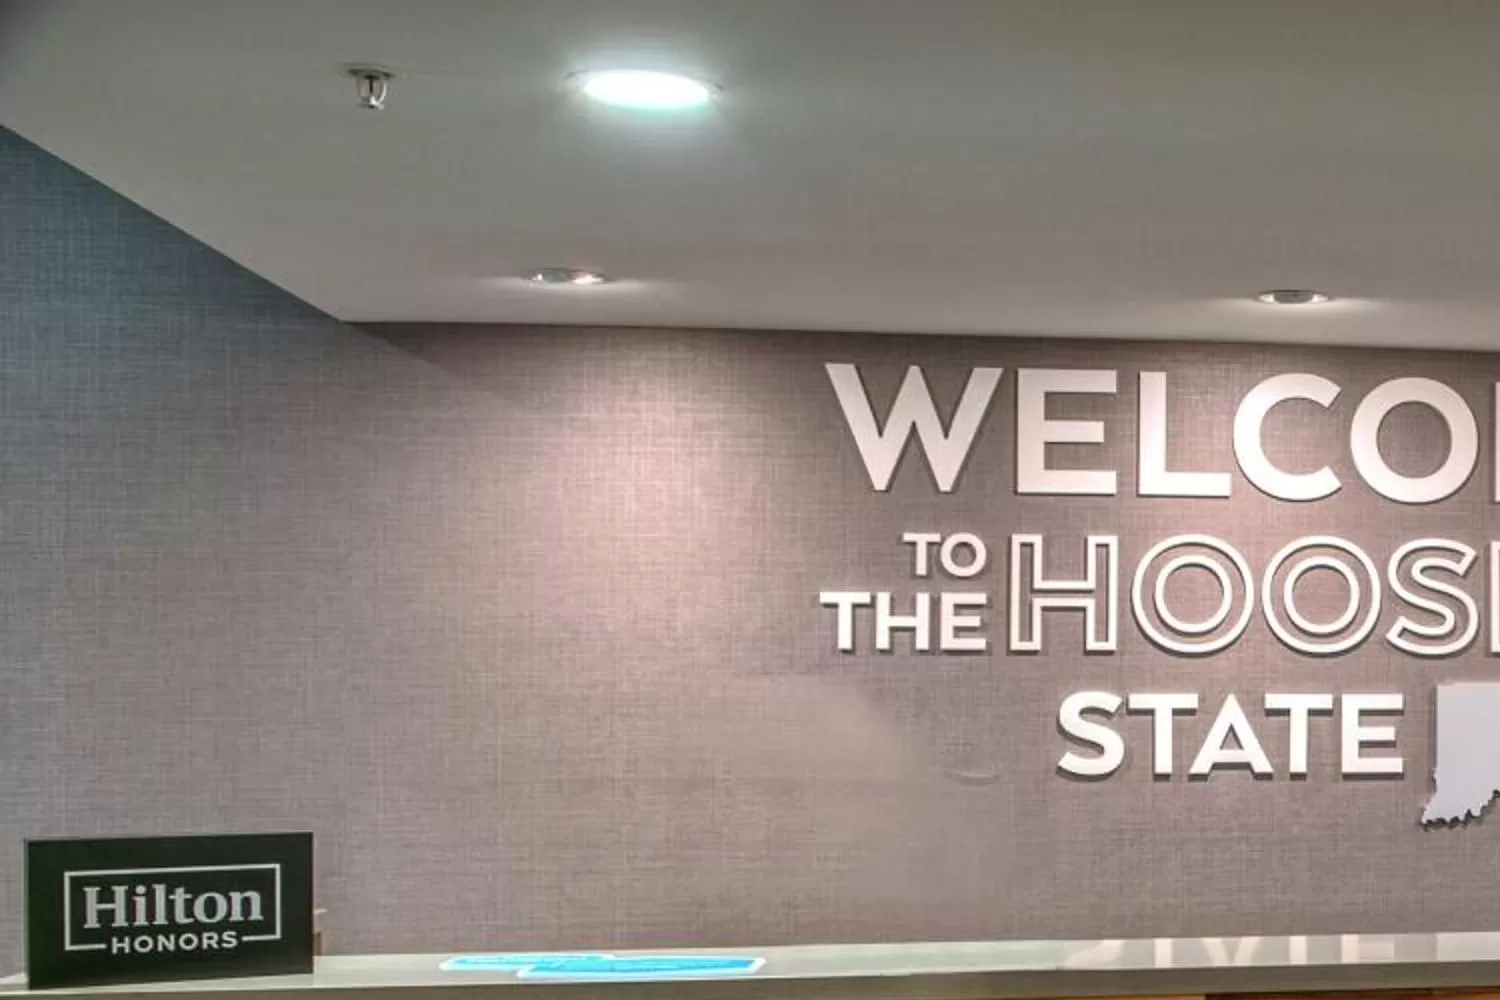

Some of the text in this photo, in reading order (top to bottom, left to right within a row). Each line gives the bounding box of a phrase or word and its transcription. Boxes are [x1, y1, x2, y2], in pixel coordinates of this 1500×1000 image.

[903, 532, 987, 577] TO
[820, 591, 987, 651] THE
[1056, 690, 1405, 777] STATE
[83, 884, 265, 929] Hilton
[111, 931, 239, 955] HONORS
